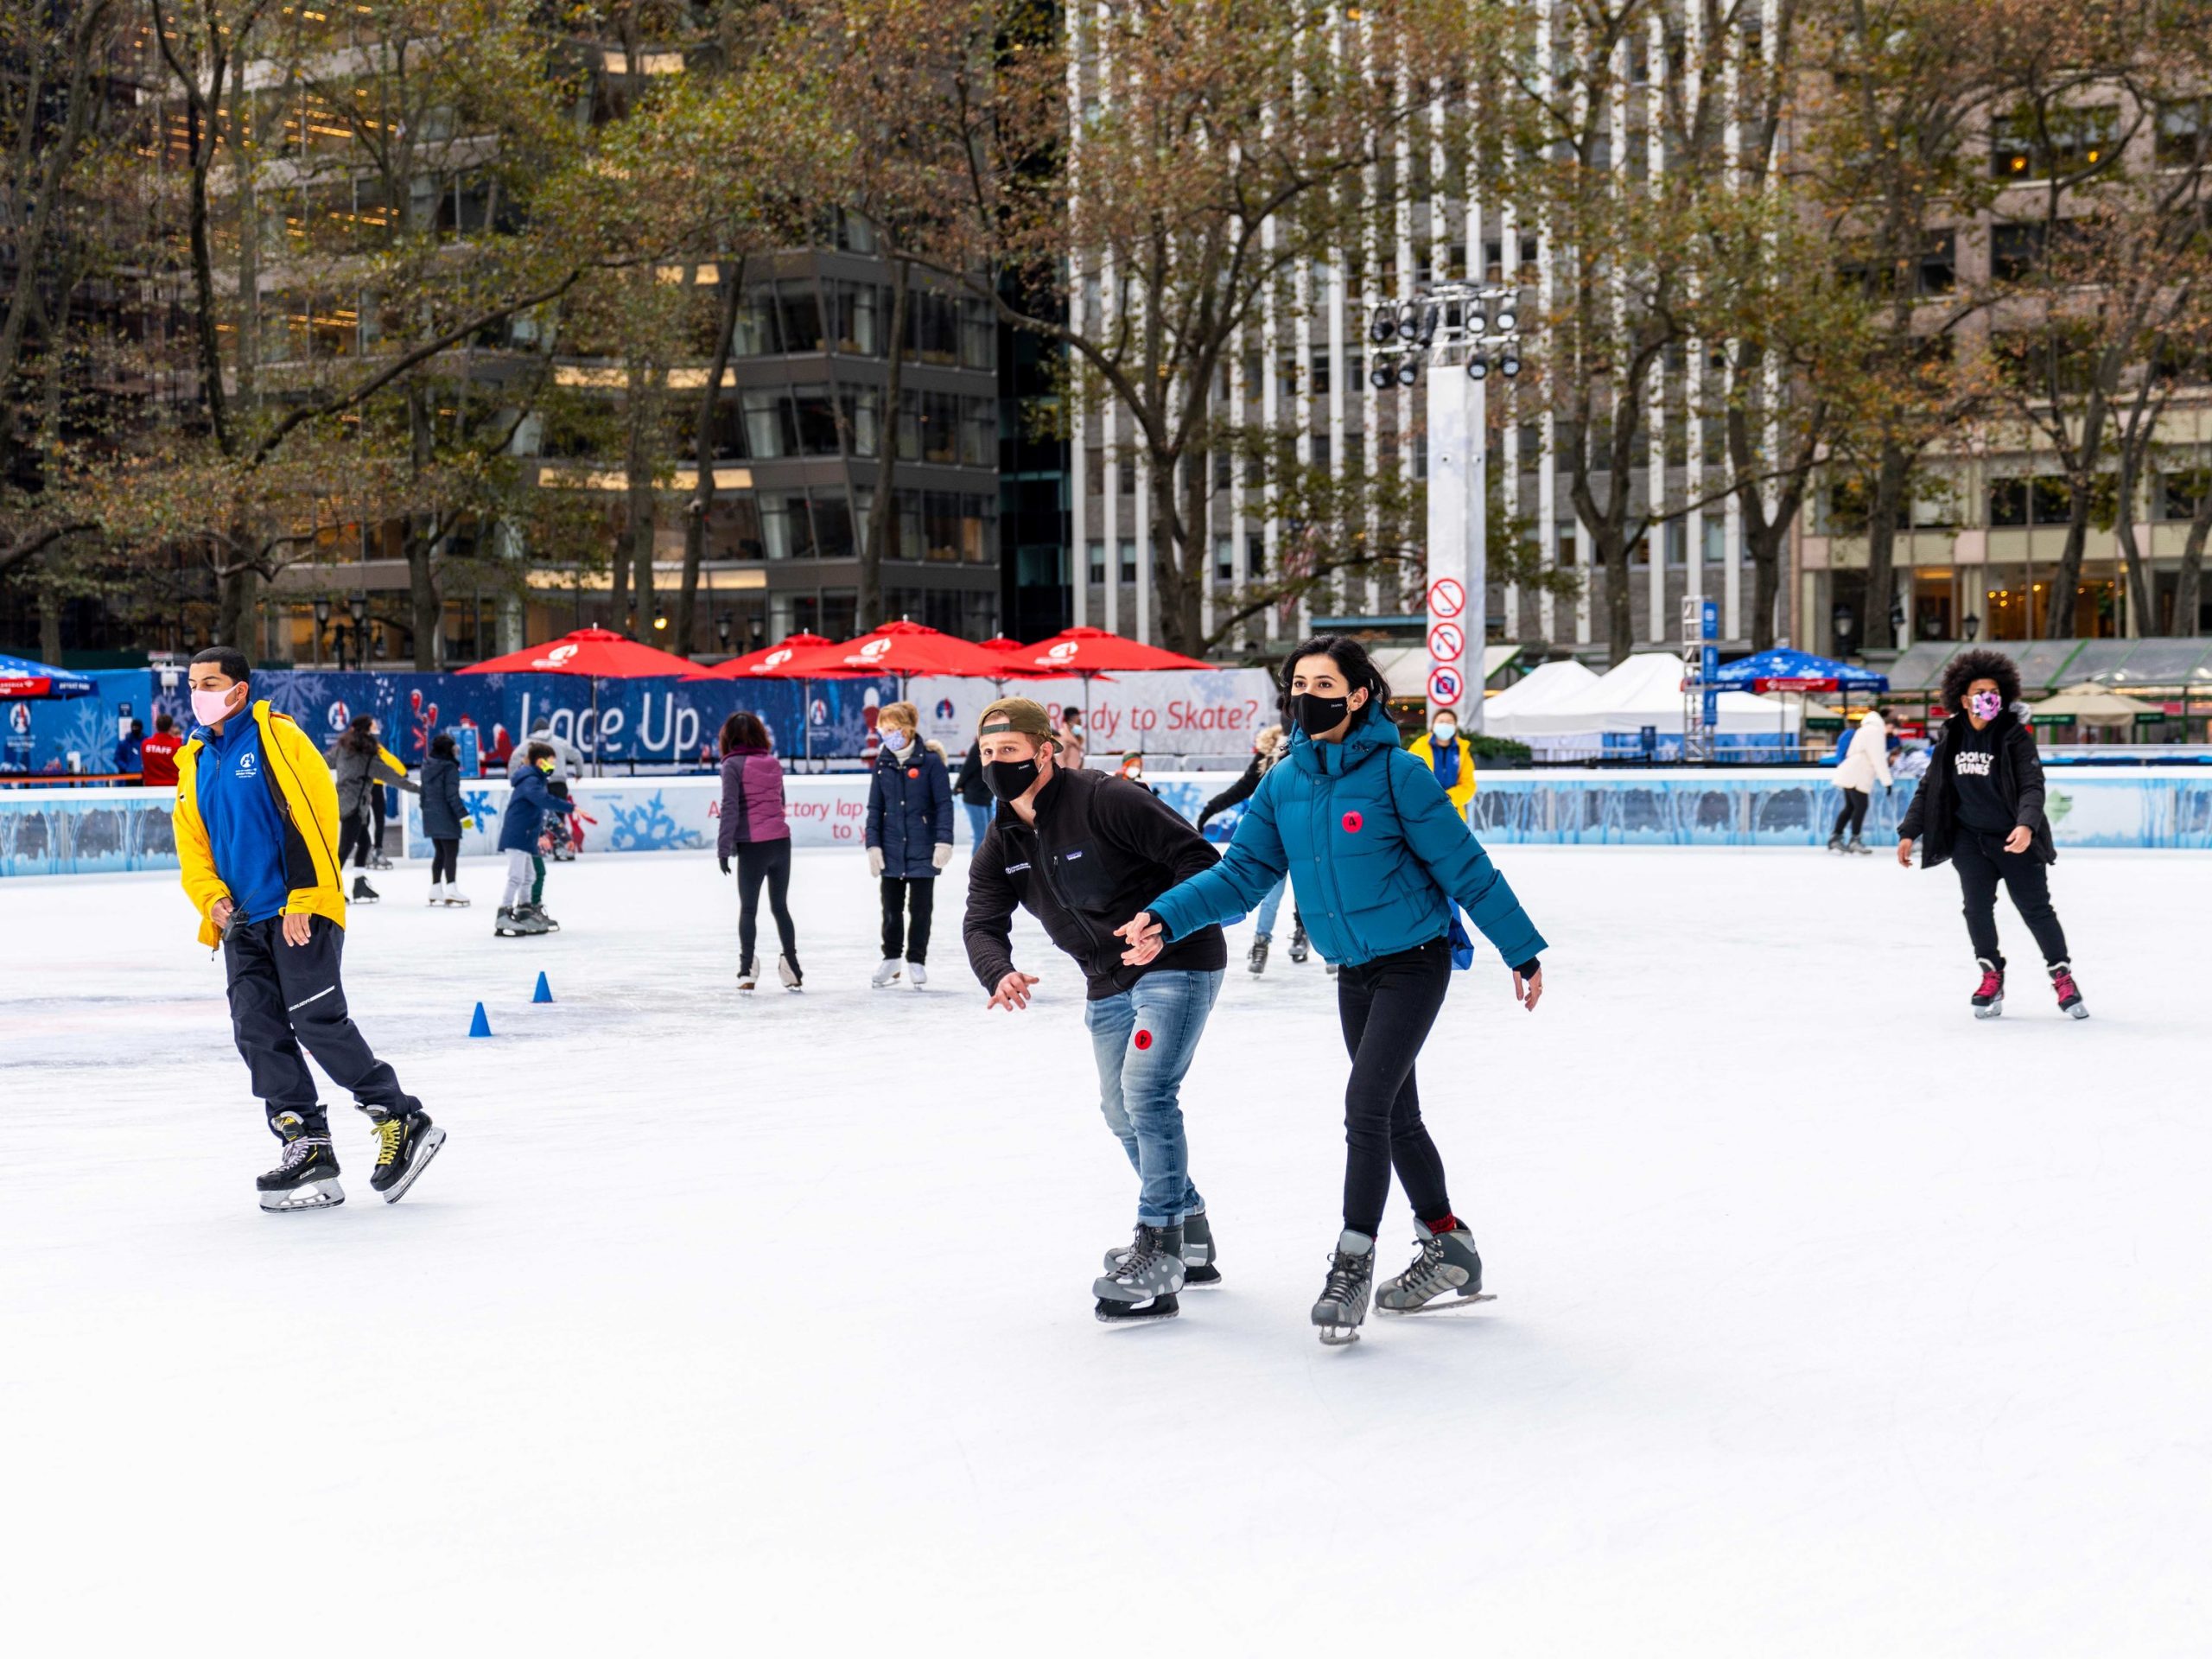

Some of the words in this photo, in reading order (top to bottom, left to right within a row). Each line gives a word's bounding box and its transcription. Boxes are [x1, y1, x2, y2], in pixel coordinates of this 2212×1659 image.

[642, 692, 699, 766] Up
[1046, 702, 1122, 739] Rdy
[1130, 705, 1157, 731] to
[1167, 699, 1259, 731] Skate?
[145, 744, 172, 754] STAFF
[1957, 762, 1990, 776] TUNES
[783, 802, 830, 822] ctory
[836, 798, 864, 821] lap
[832, 823, 852, 840] to
